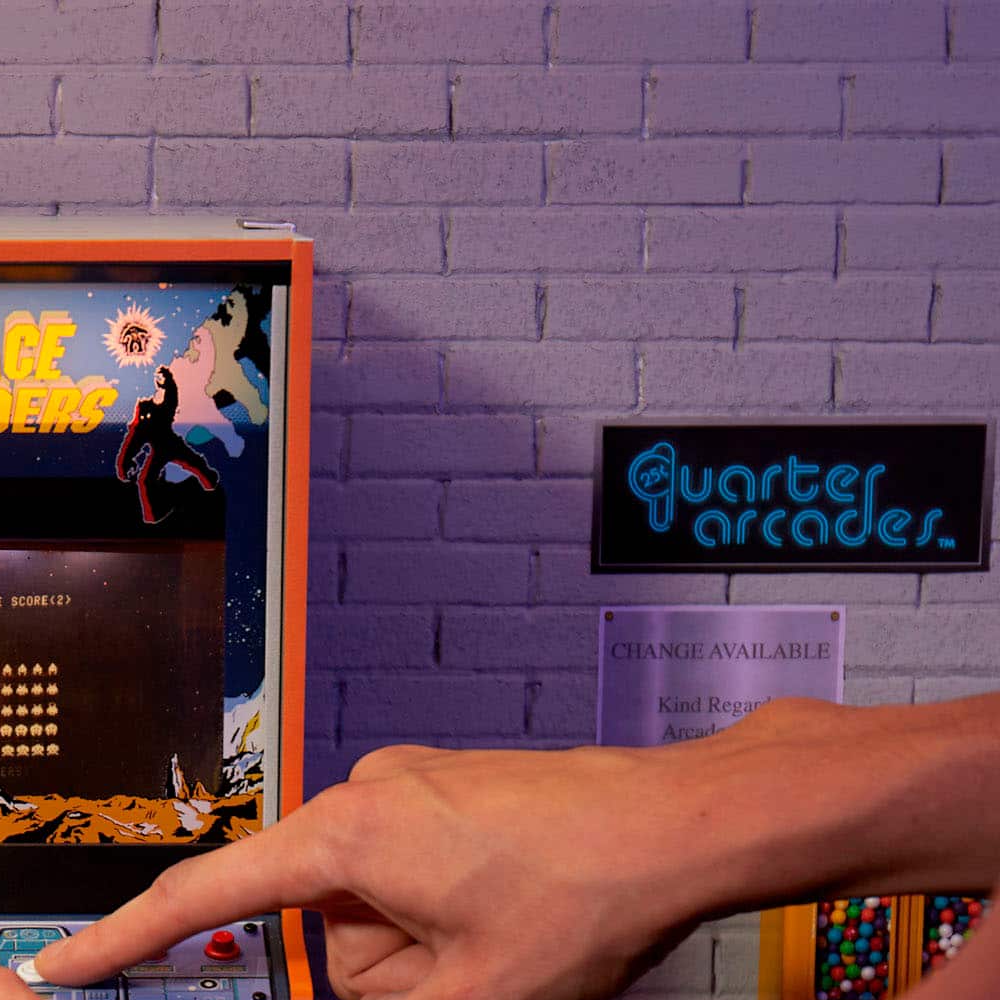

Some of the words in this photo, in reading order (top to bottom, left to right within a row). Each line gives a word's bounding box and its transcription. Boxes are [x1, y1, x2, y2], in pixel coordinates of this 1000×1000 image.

[628, 442, 886, 532] quarter
[694, 509, 943, 547] arcades
[611, 641, 703, 660] CHANGE
[708, 641, 832, 660] AVAILABLE
[658, 696, 701, 713] Kind
[662, 722, 725, 740] Arcad
